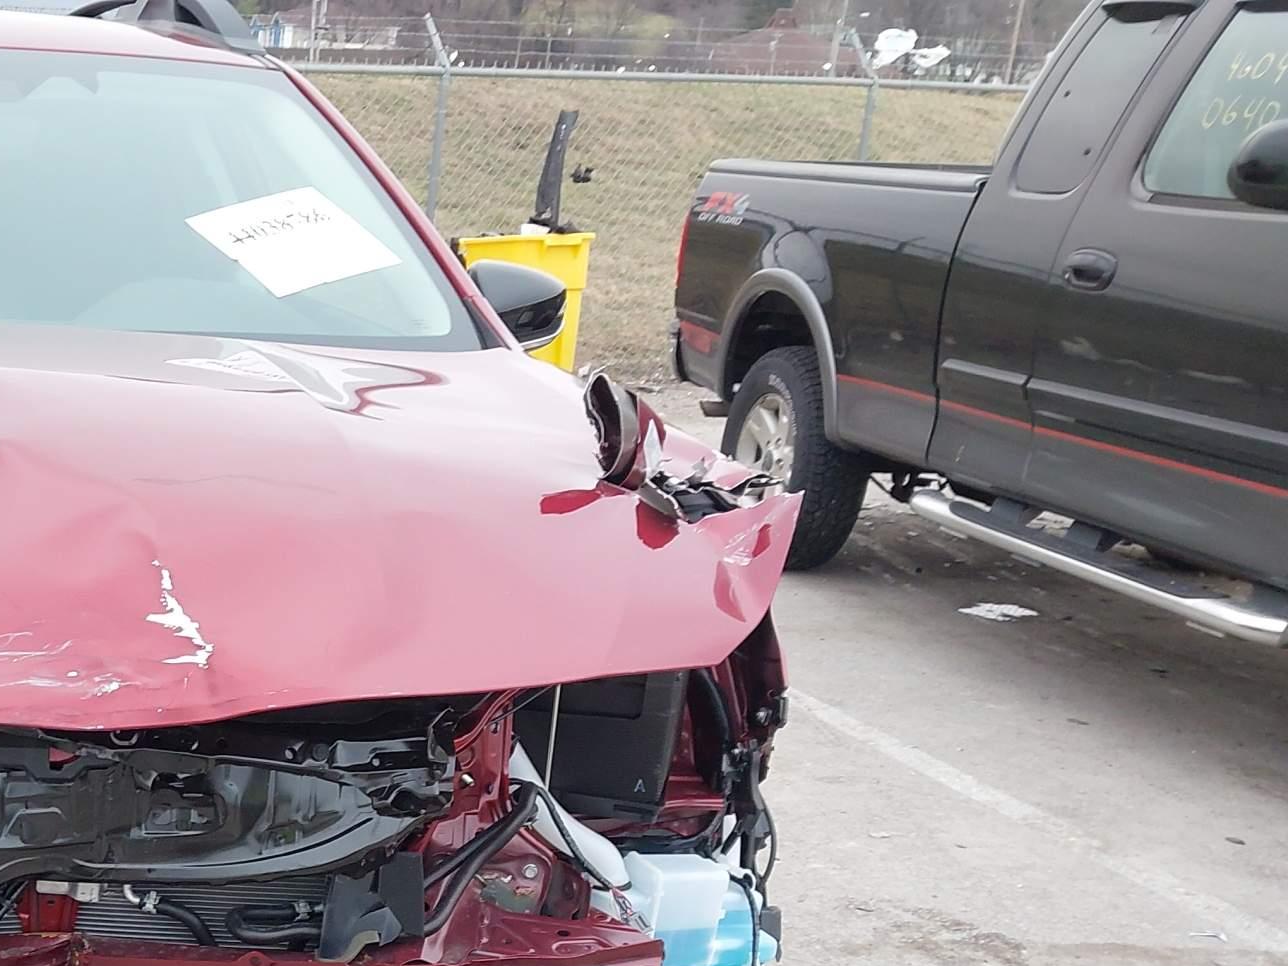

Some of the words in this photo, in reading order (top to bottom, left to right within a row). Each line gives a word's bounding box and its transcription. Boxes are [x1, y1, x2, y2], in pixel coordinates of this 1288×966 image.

[1202, 95, 1281, 130] 0640
[702, 192, 751, 215] FX4
[697, 212, 717, 223] OFF
[715, 214, 744, 226] ROAD
[634, 779, 646, 793] A
